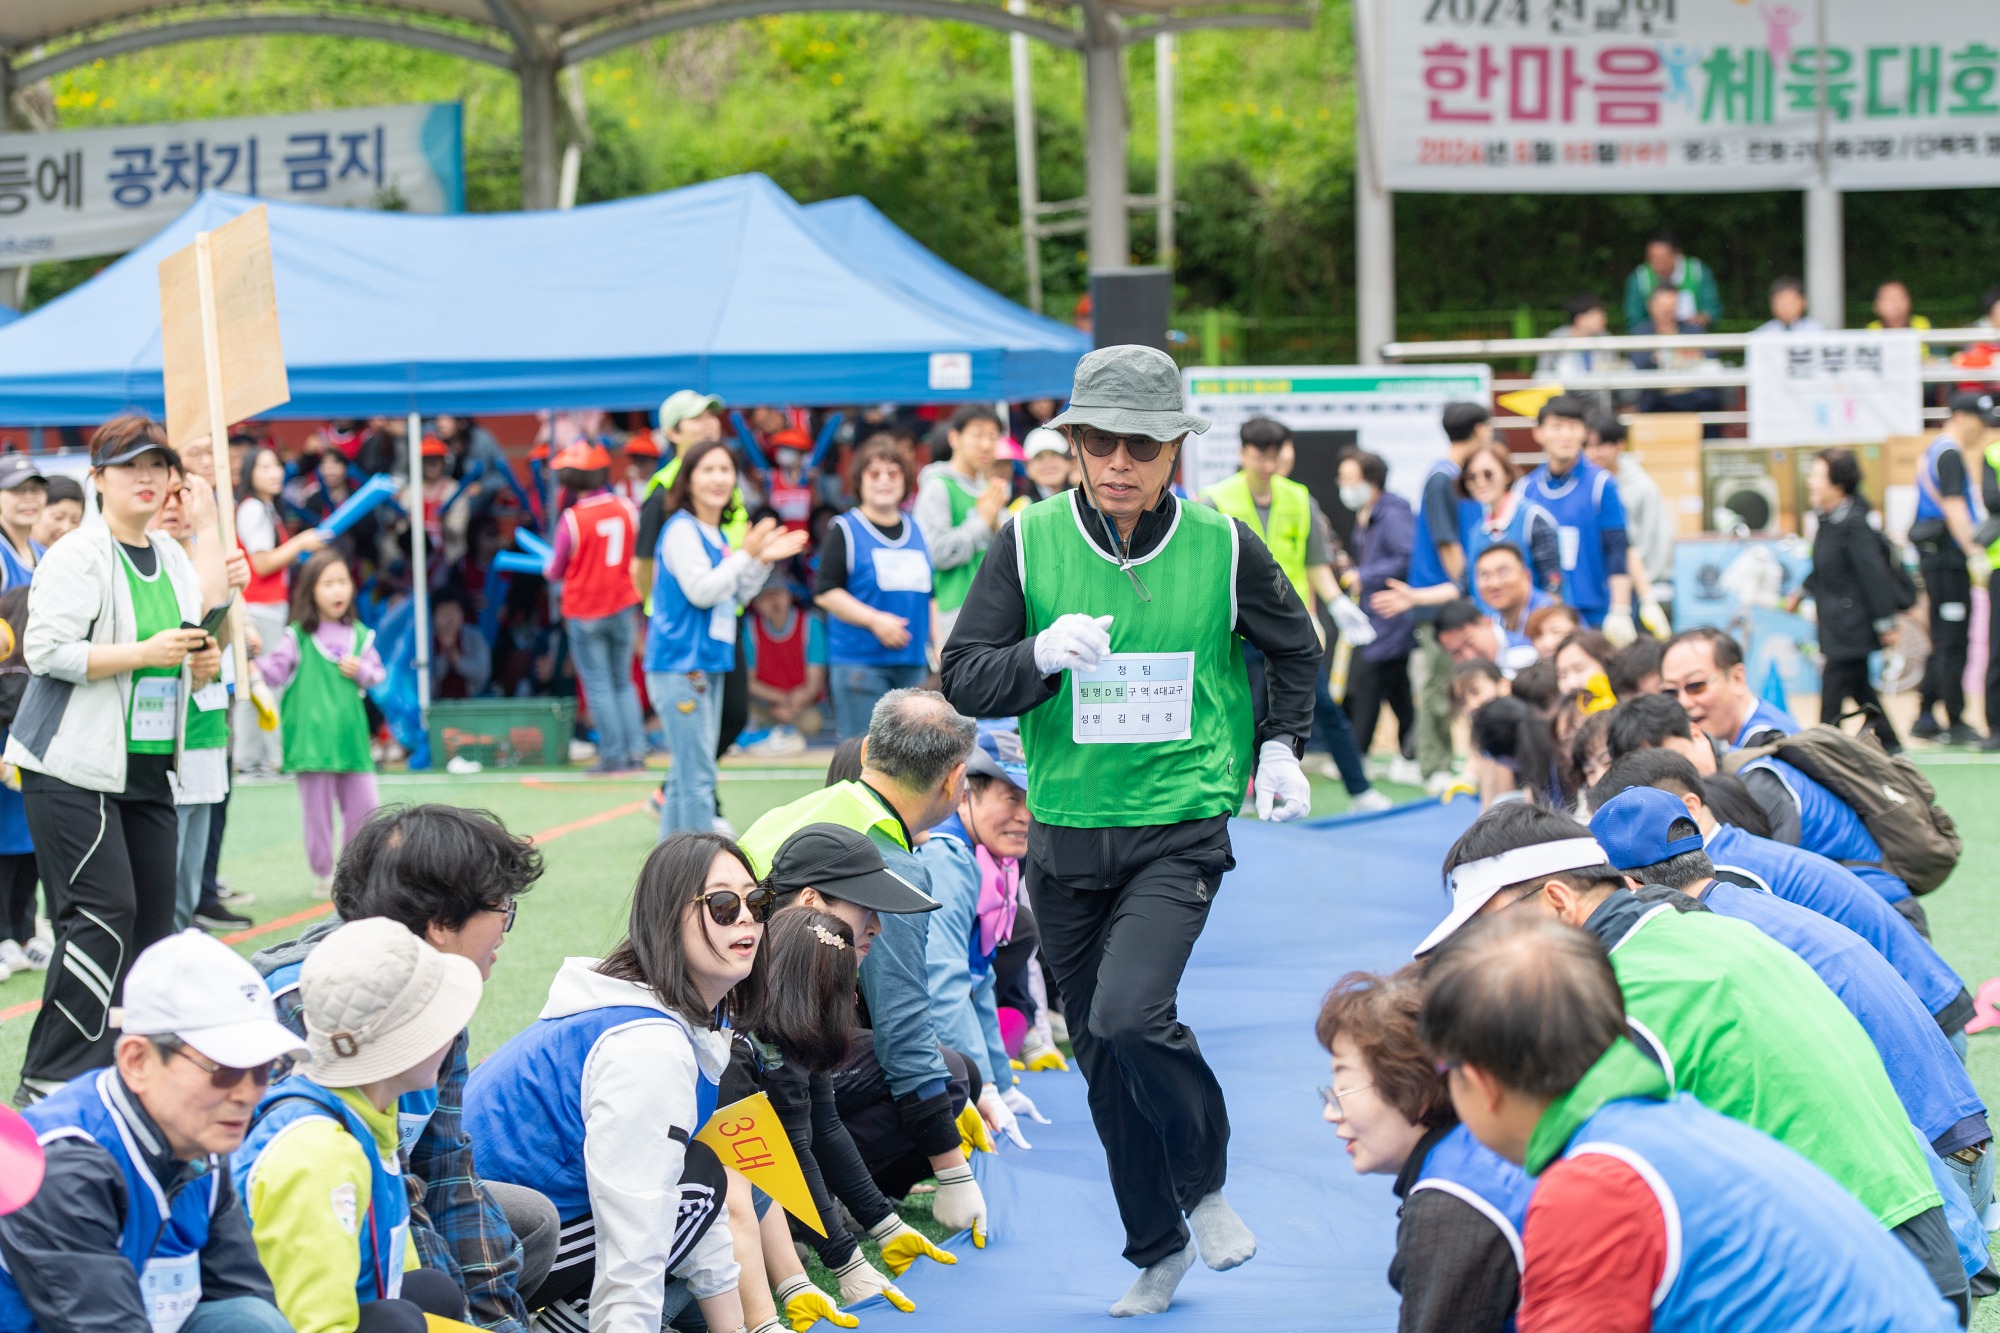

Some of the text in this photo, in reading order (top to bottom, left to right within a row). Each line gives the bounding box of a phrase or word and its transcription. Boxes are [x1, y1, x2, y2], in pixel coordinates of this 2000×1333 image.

[1423, 40, 1665, 125] 한마음
[108, 136, 258, 208] 공차기
[283, 124, 385, 193] 금지
[595, 516, 625, 567] 7
[1153, 685, 1184, 696] 4대교구
[718, 1116, 776, 1171] 3대
